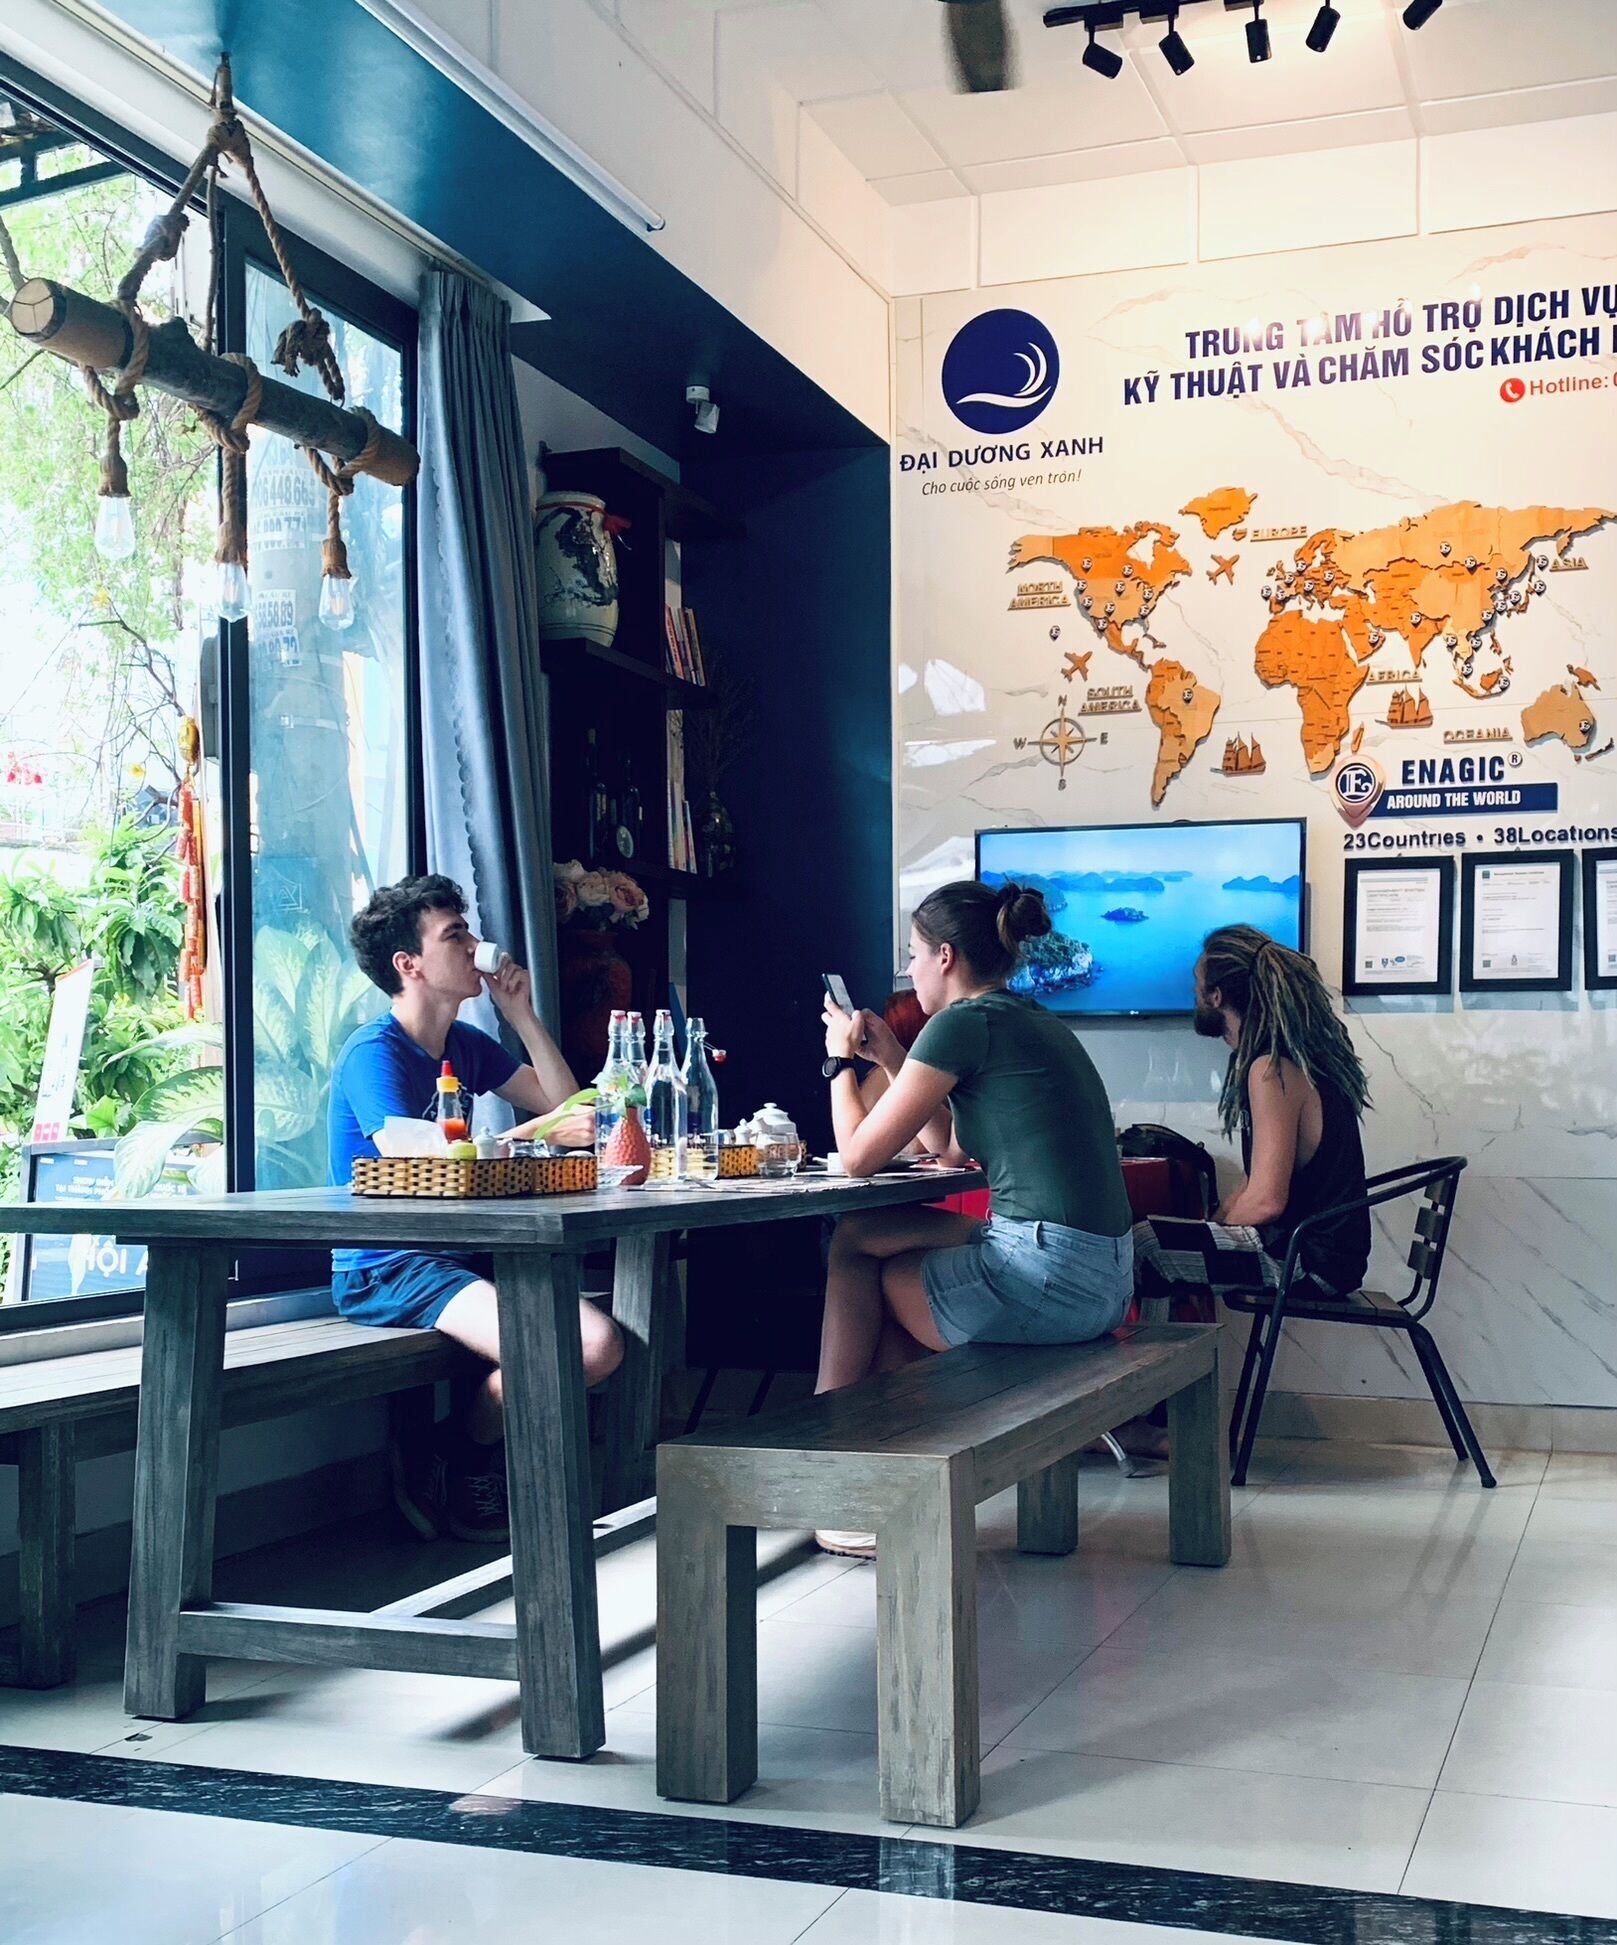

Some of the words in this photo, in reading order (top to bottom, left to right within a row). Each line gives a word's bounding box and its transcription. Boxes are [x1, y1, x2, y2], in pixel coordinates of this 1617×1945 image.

[1185, 322, 1284, 359] TRUNG
[1422, 298, 1483, 333] TRỢ
[1494, 289, 1569, 328] DỊCH
[1124, 370, 1160, 405] KỸ
[1170, 361, 1263, 400] THUẬT
[1273, 353, 1311, 389] VÀ
[1318, 345, 1409, 385] CHĂM
[1421, 336, 1484, 374] SÓC
[1491, 326, 1599, 366] KHÁCH
[1530, 376, 1608, 396] Hotline:
[900, 452, 937, 474] ĐẠI
[949, 443, 1030, 467] DƯƠNG
[1041, 436, 1103, 458] XANH
[922, 481, 946, 495] Cho
[950, 478, 980, 493] cuộc
[984, 473, 1015, 491] sống
[1252, 526, 1307, 538] EUROPE
[1551, 557, 1587, 570] ASIA
[1017, 581, 1063, 595] NORTH
[1010, 596, 1069, 609] AMERICA
[1368, 670, 1421, 682] AFRICA
[1087, 686, 1133, 699] SOUTH
[1080, 700, 1140, 713] AMERICA
[1444, 727, 1512, 740] OCEANIA
[1402, 756, 1505, 784] ENAGIC
[1387, 793, 1441, 809] AROUND
[1445, 792, 1469, 807] THE
[1473, 790, 1521, 806] WORLD
[1343, 831, 1466, 850] 23Countries
